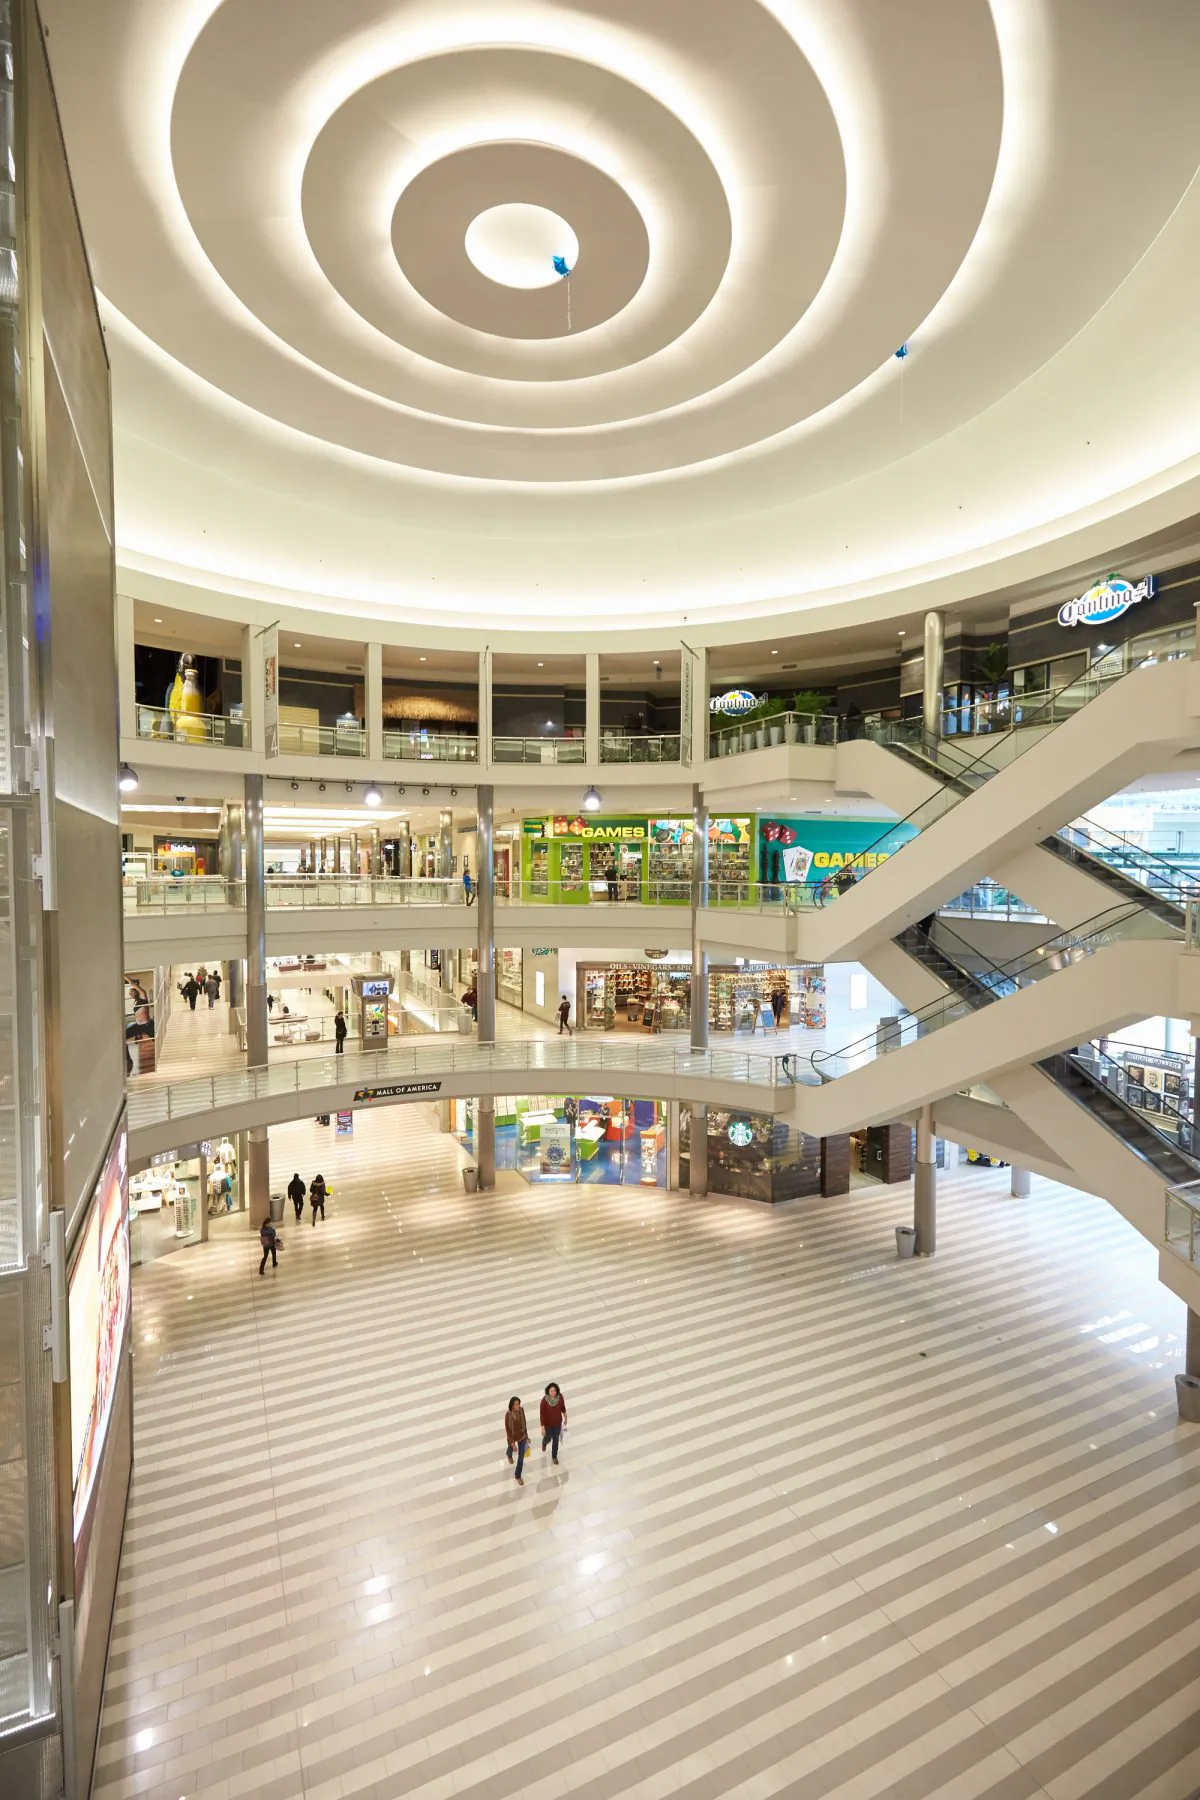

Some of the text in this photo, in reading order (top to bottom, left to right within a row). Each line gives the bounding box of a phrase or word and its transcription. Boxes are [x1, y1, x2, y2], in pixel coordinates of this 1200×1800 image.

[581, 826, 645, 838] GAMES
[376, 1083, 437, 1096] MALL OF AMERICA
